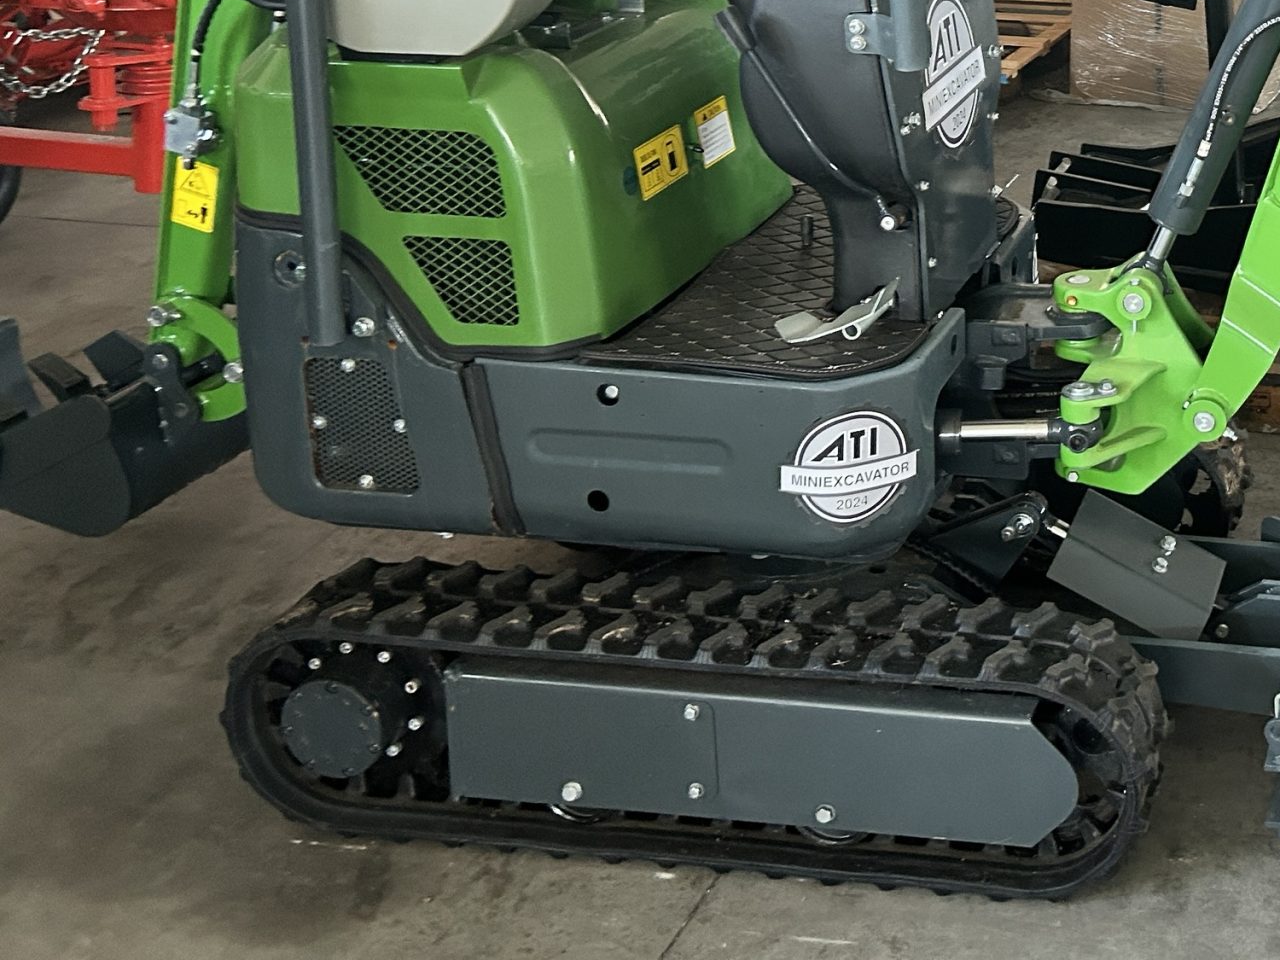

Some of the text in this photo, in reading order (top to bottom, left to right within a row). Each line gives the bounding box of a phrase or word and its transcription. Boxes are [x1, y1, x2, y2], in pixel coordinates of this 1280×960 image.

[933, 12, 961, 74] ATI
[810, 426, 878, 462] ATI
[791, 461, 909, 488] MINIEXCAVATOR
[836, 495, 868, 511] 2024
